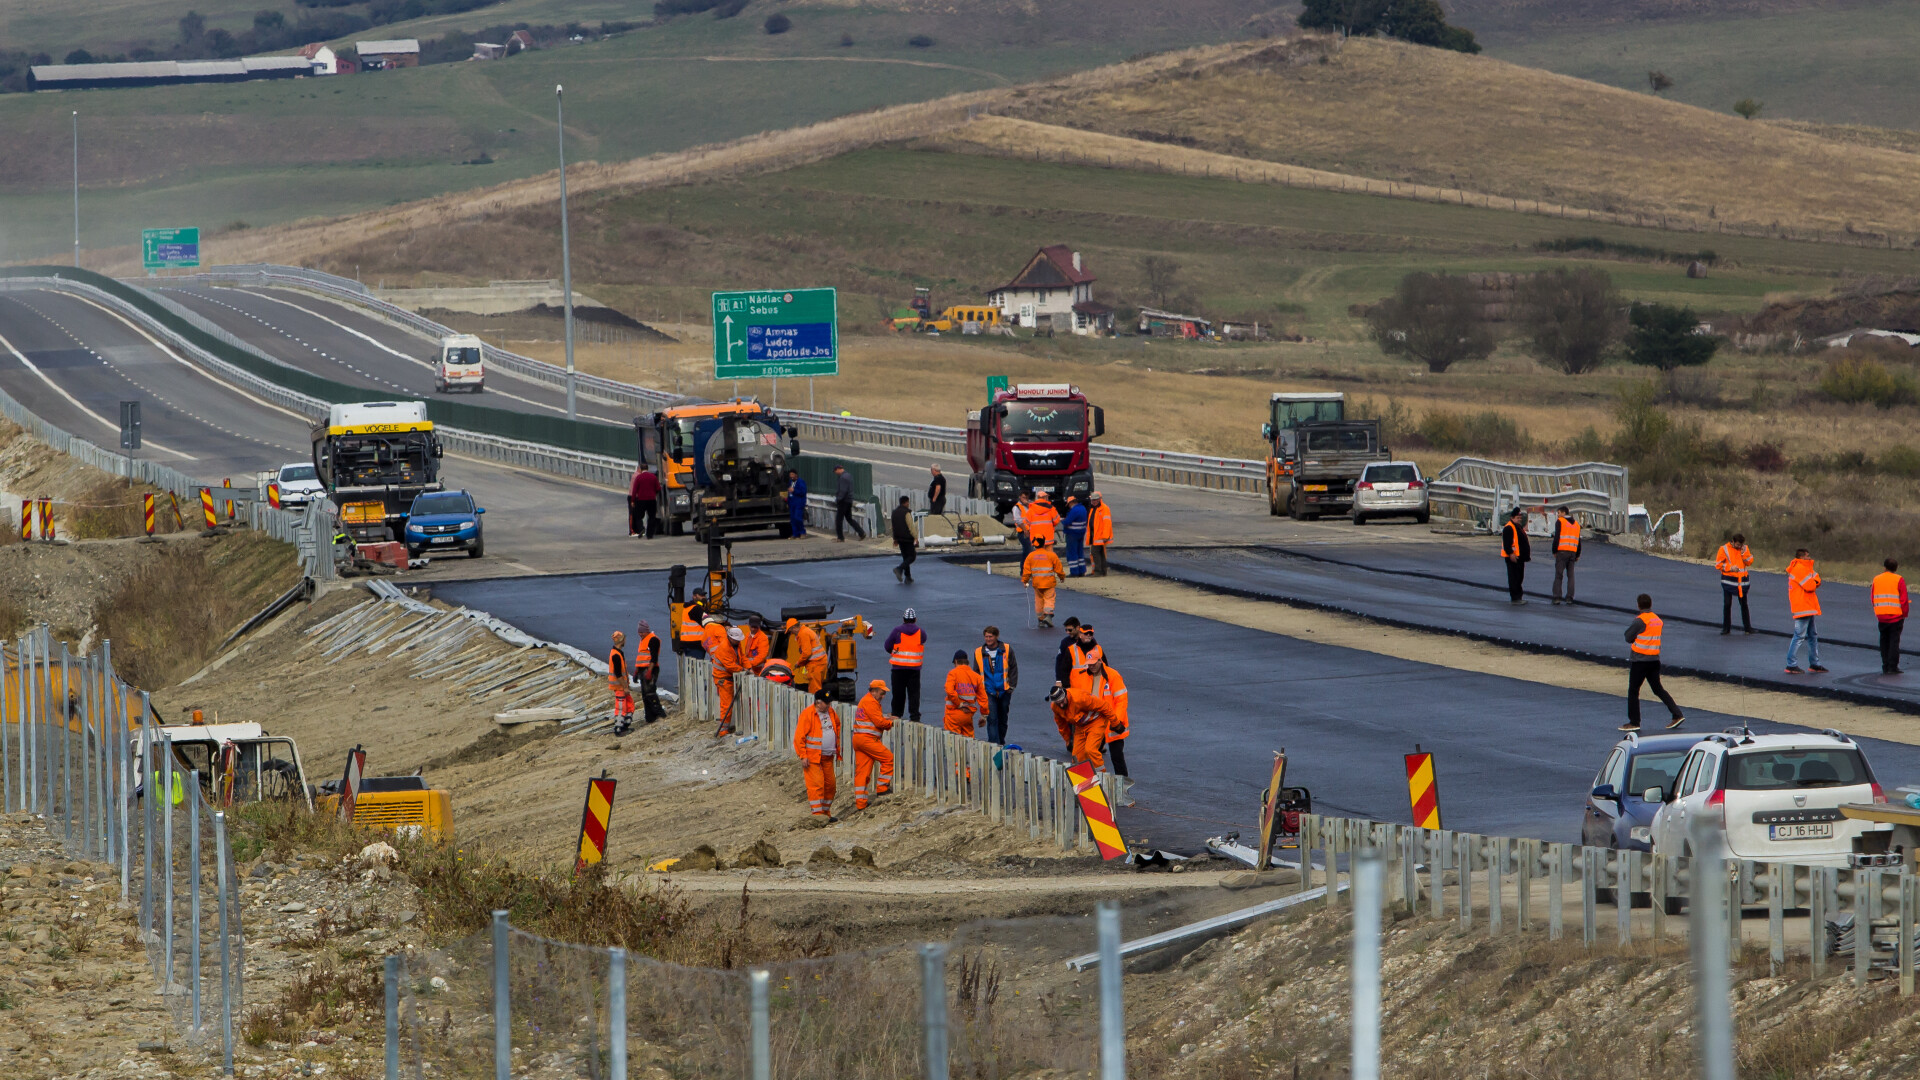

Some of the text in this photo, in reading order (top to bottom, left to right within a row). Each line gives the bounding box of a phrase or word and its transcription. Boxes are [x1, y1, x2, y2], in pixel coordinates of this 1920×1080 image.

[733, 300, 743, 309] A1
[766, 346, 830, 358] Apoldu de Jos
[1779, 826, 1792, 836] CJ
[1796, 826, 1805, 835] 16
[1808, 825, 1829, 835] HHJ
